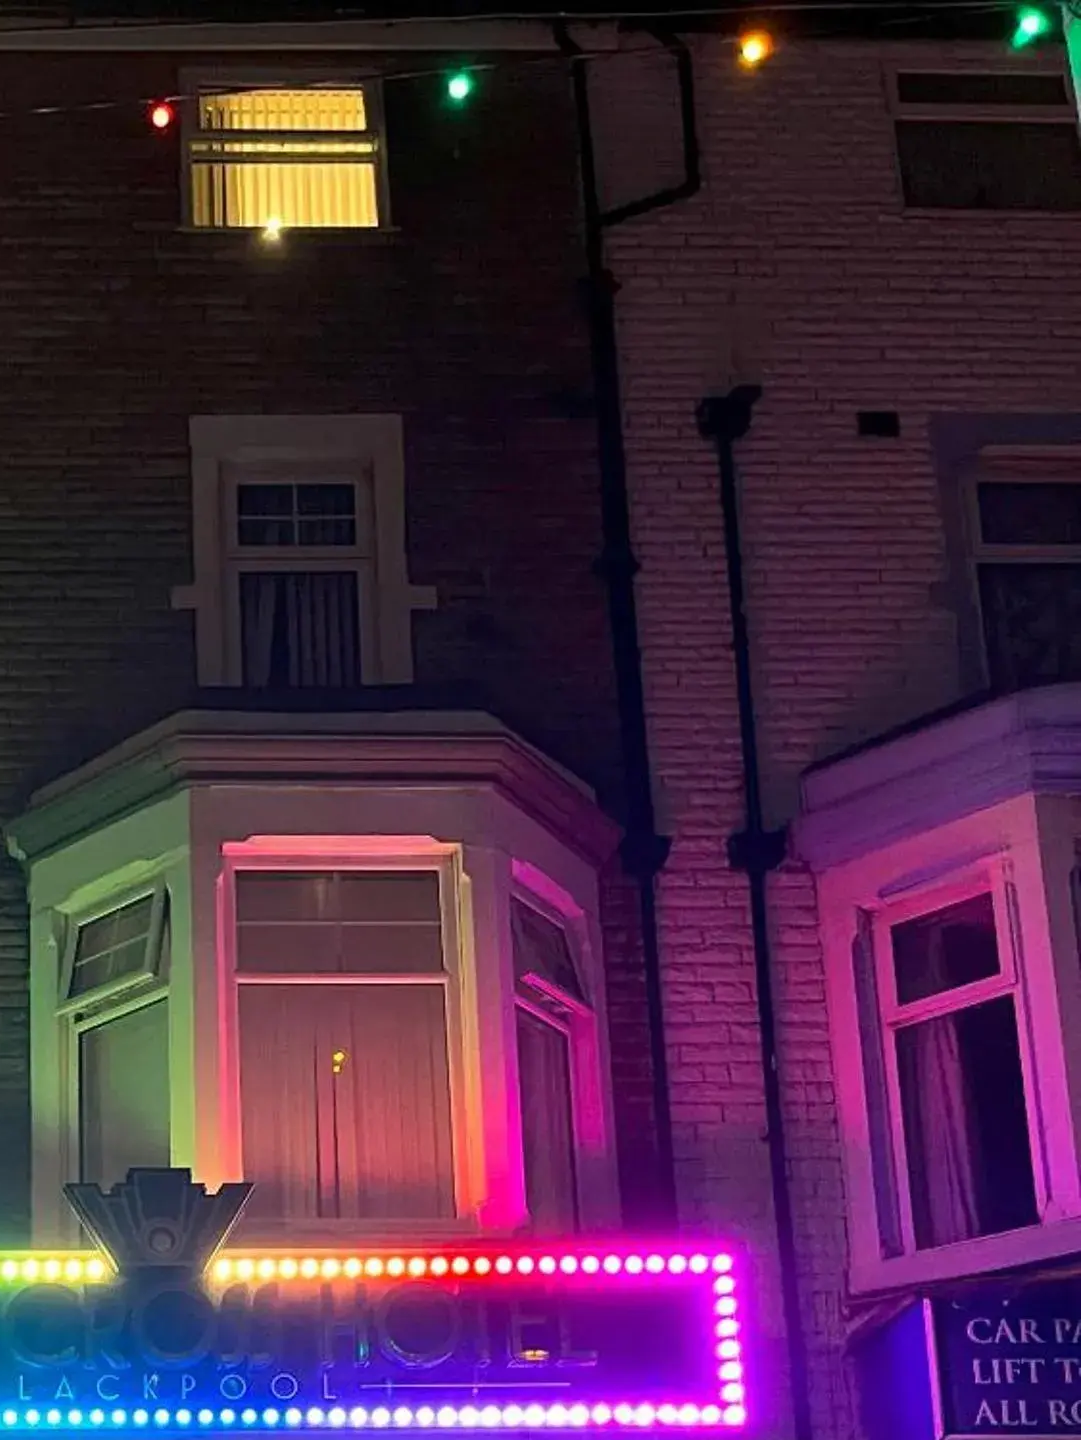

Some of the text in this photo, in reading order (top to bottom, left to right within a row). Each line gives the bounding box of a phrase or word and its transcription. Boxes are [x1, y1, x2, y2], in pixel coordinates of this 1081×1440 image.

[318, 1280, 599, 1369] HOTEL
[966, 1317, 1046, 1344] CAR
[972, 1358, 1081, 1385] LIFT T
[975, 1398, 1038, 1426] ALL
